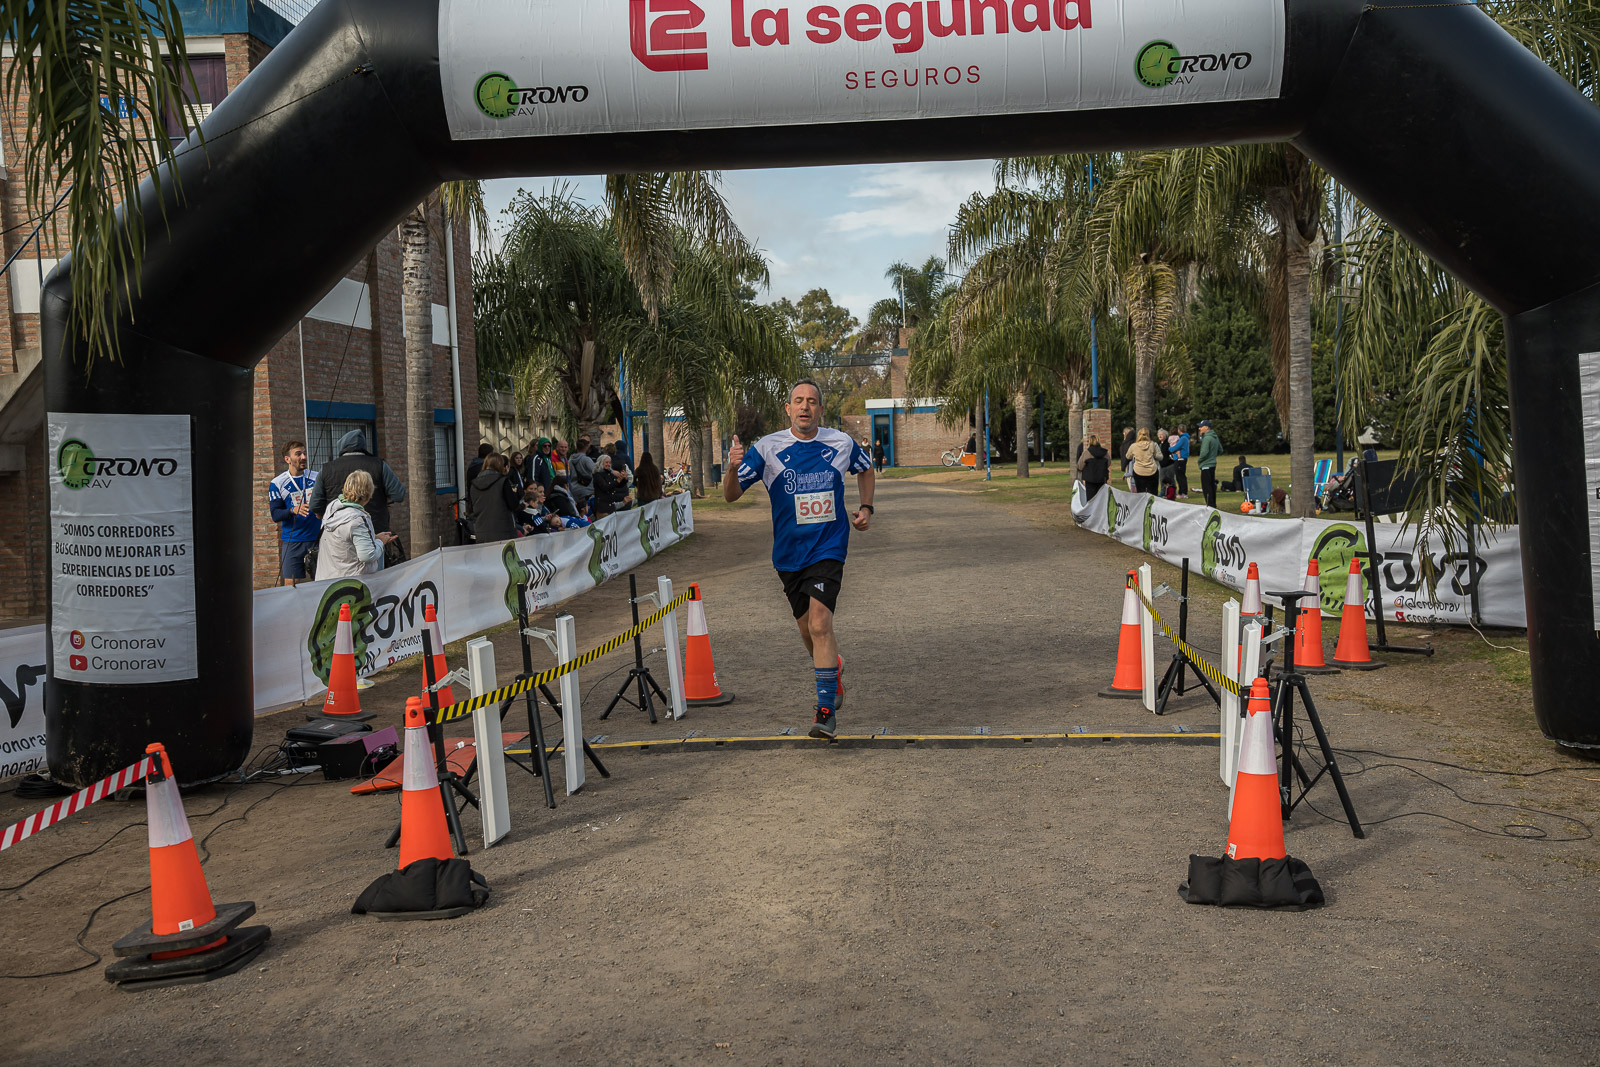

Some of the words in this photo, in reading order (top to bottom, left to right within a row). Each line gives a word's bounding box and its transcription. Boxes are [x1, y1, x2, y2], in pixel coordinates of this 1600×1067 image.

[731, 0, 789, 47] la
[805, 0, 1093, 54] segunda
[1167, 52, 1252, 73] CRONO
[845, 65, 981, 90] SEGUROS
[1164, 76, 1194, 86] RAV
[507, 86, 588, 105] CRONO
[507, 107, 535, 117] RAV
[82, 457, 178, 477] CRONO
[81, 479, 112, 489] RAV
[784, 469, 796, 495] 3
[800, 499, 832, 517] 502
[97, 525, 175, 538] CORREDORES
[55, 542, 101, 557] BUSCANDO
[105, 545, 161, 558] MEJORAR
[164, 544, 186, 557] LAS
[62, 562, 132, 578] EXPERIENCIAS
[135, 566, 150, 577] DE
[153, 564, 176, 577] LOS
[91, 635, 166, 650] Cronorav
[91, 656, 167, 671] Cronorav
